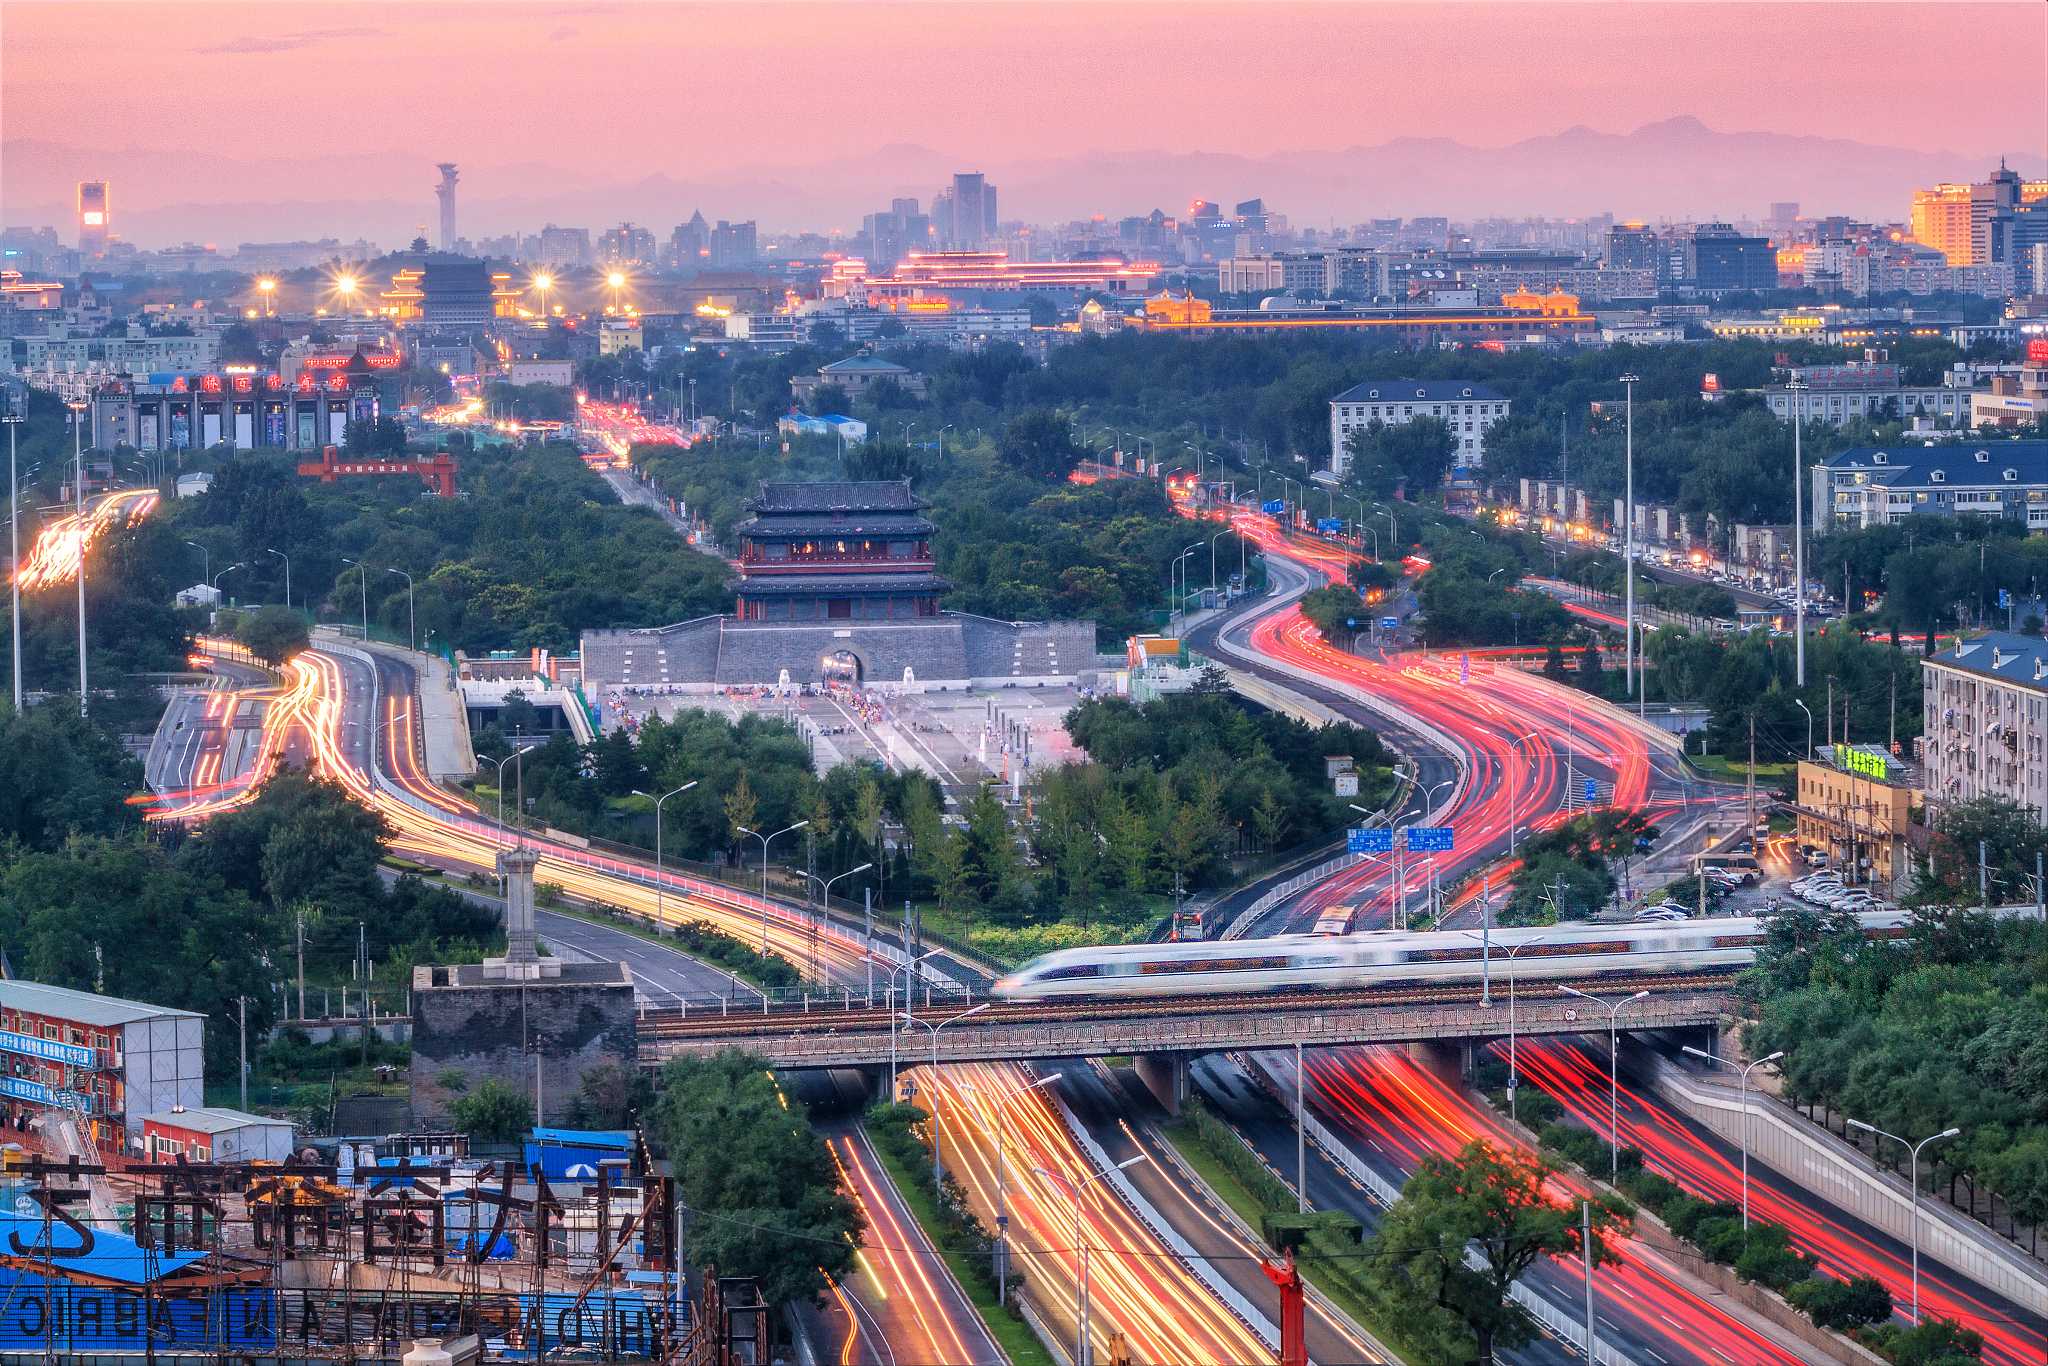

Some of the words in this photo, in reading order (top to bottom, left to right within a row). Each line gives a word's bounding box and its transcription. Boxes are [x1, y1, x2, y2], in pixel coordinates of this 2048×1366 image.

[1810, 368, 1894, 379] 北京口腔医院
[173, 375, 347, 391] 天桥百货商场
[345, 465, 408, 473] 中国中铁五局
[15, 1082, 41, 1098] 创知名企业
